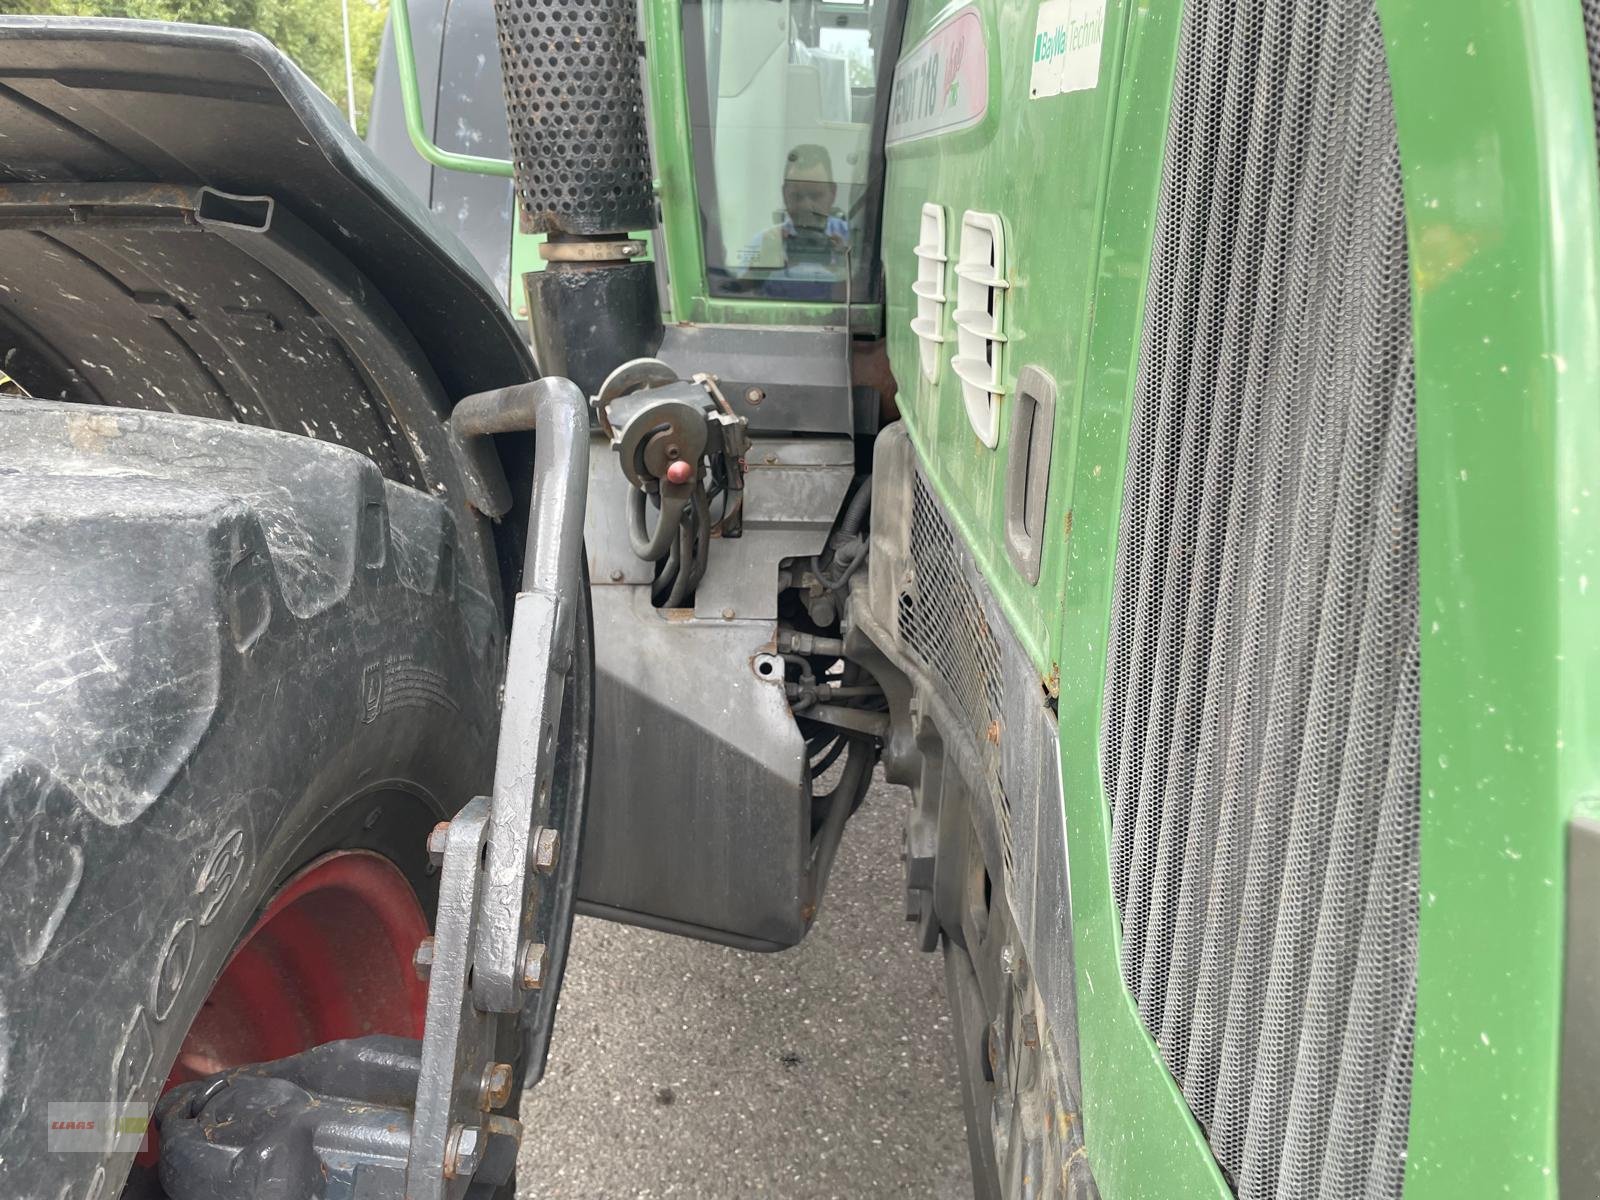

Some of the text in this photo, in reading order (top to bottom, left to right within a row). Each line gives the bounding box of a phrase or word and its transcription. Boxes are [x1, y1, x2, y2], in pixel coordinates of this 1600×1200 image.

[1041, 7, 1103, 64] BayWa Technik
[918, 52, 940, 119] 718
